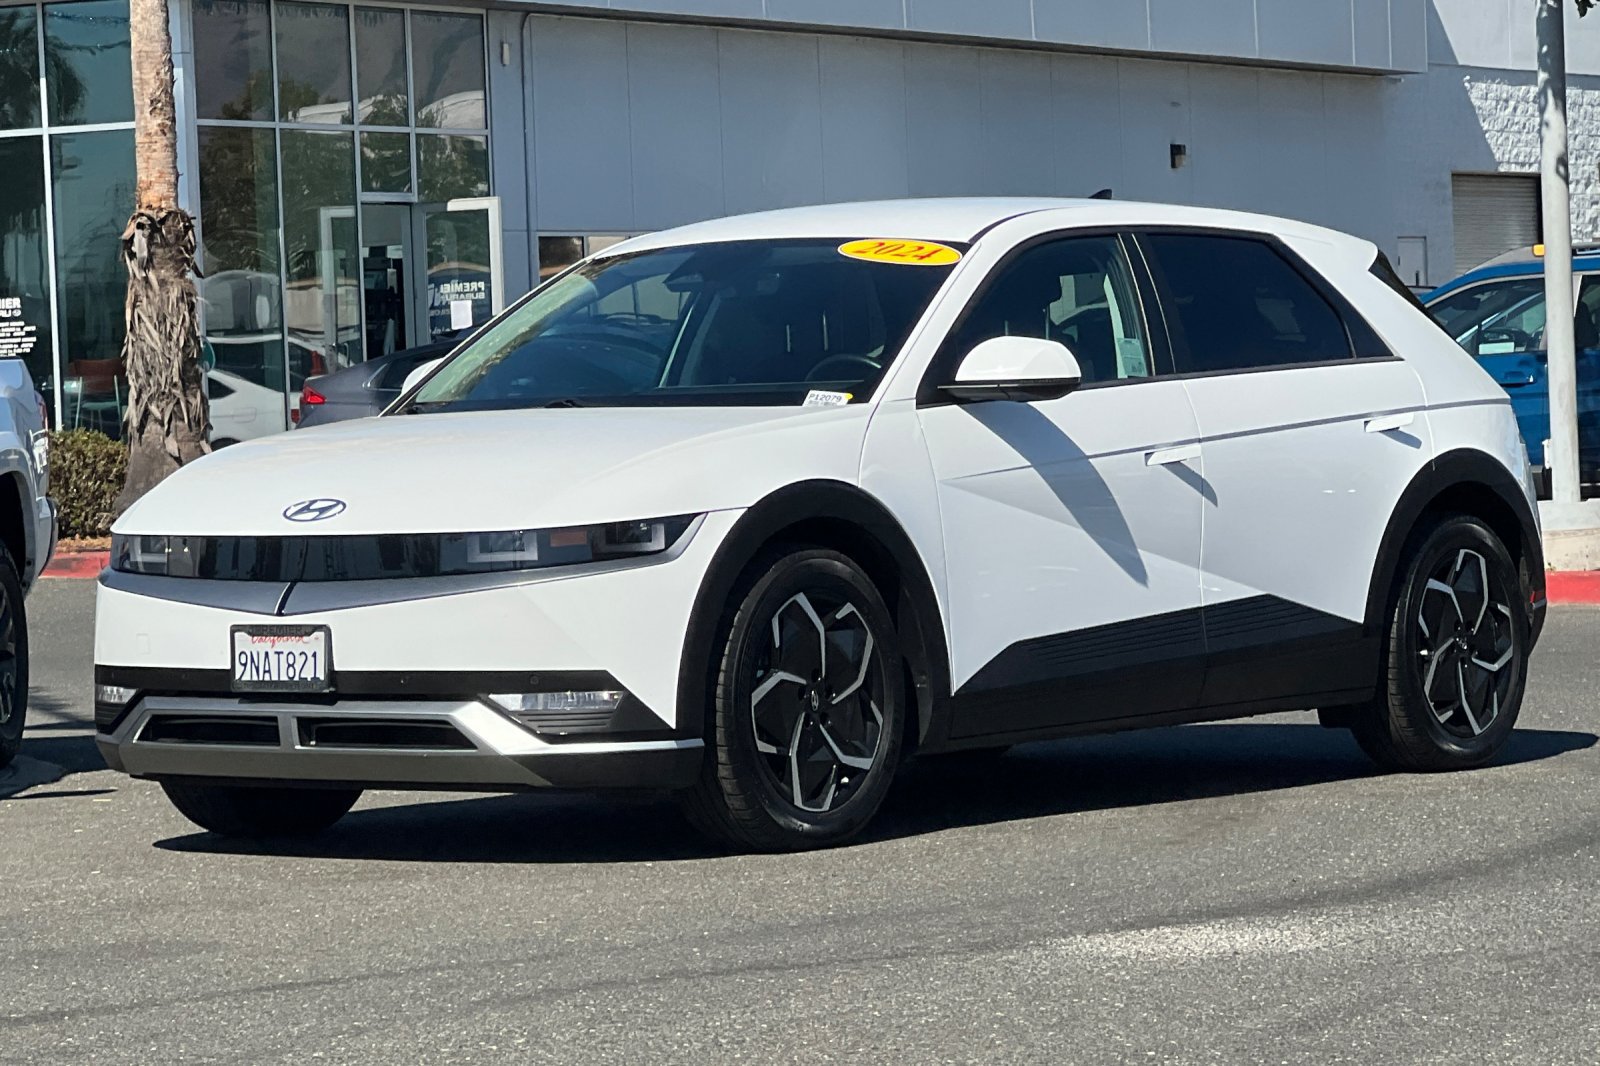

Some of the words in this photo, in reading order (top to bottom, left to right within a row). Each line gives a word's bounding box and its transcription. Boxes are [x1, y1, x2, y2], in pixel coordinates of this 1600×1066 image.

[0, 297, 21, 309] IER
[808, 393, 842, 402] P12079
[238, 651, 321, 681] 9NAT821
